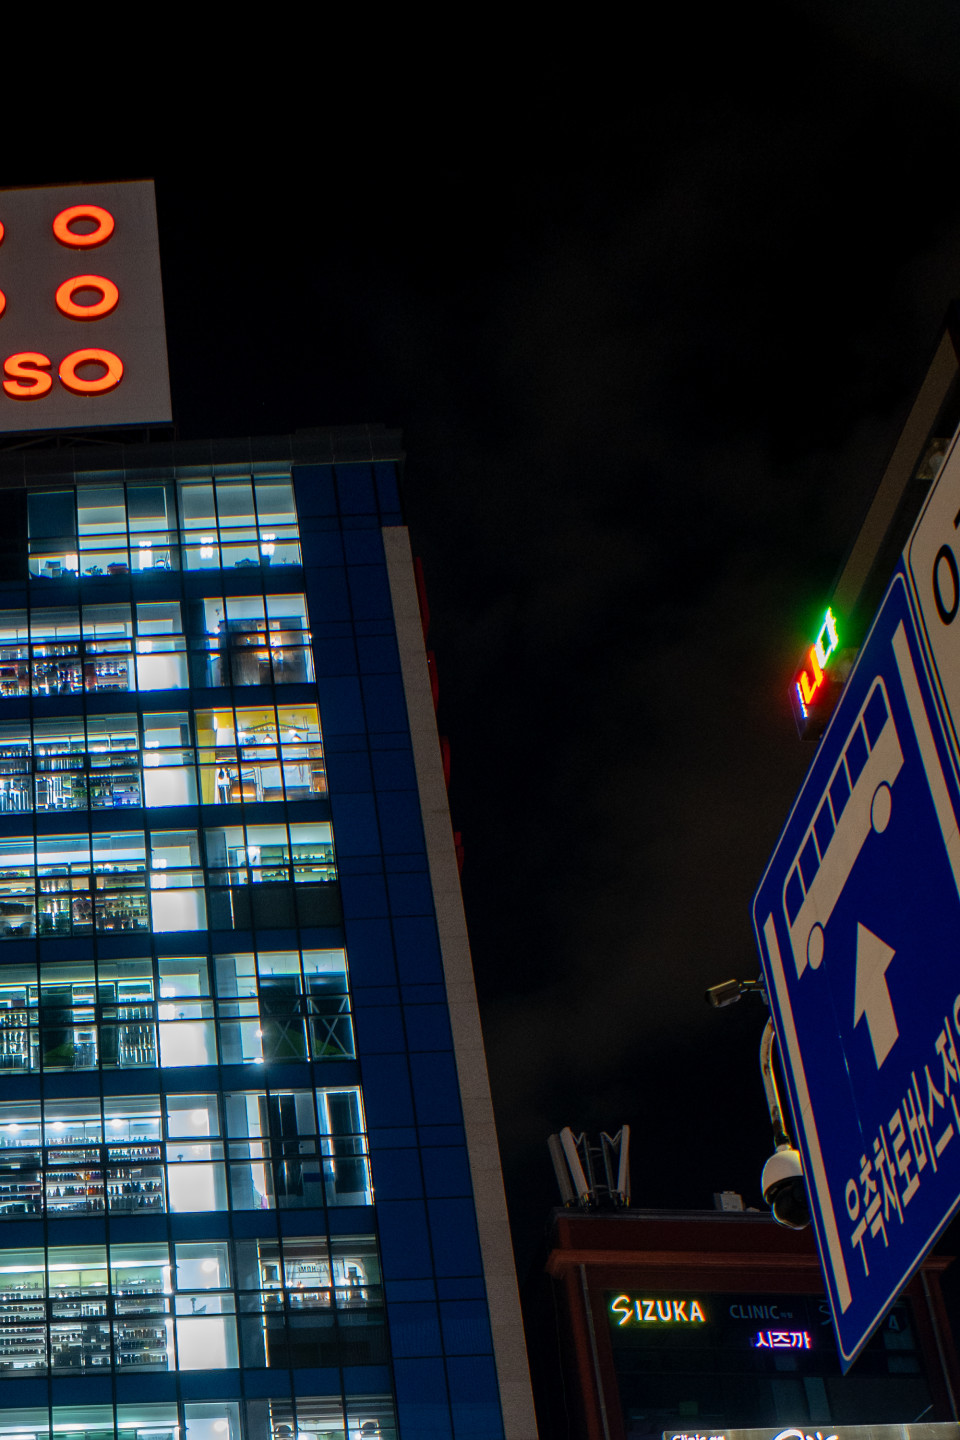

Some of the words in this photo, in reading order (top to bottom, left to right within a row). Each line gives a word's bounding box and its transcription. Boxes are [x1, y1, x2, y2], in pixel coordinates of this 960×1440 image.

[612, 1294, 707, 1325] SIZUKA
[729, 1303, 779, 1319] CLINIC
[755, 1330, 811, 1349] 시즈까
